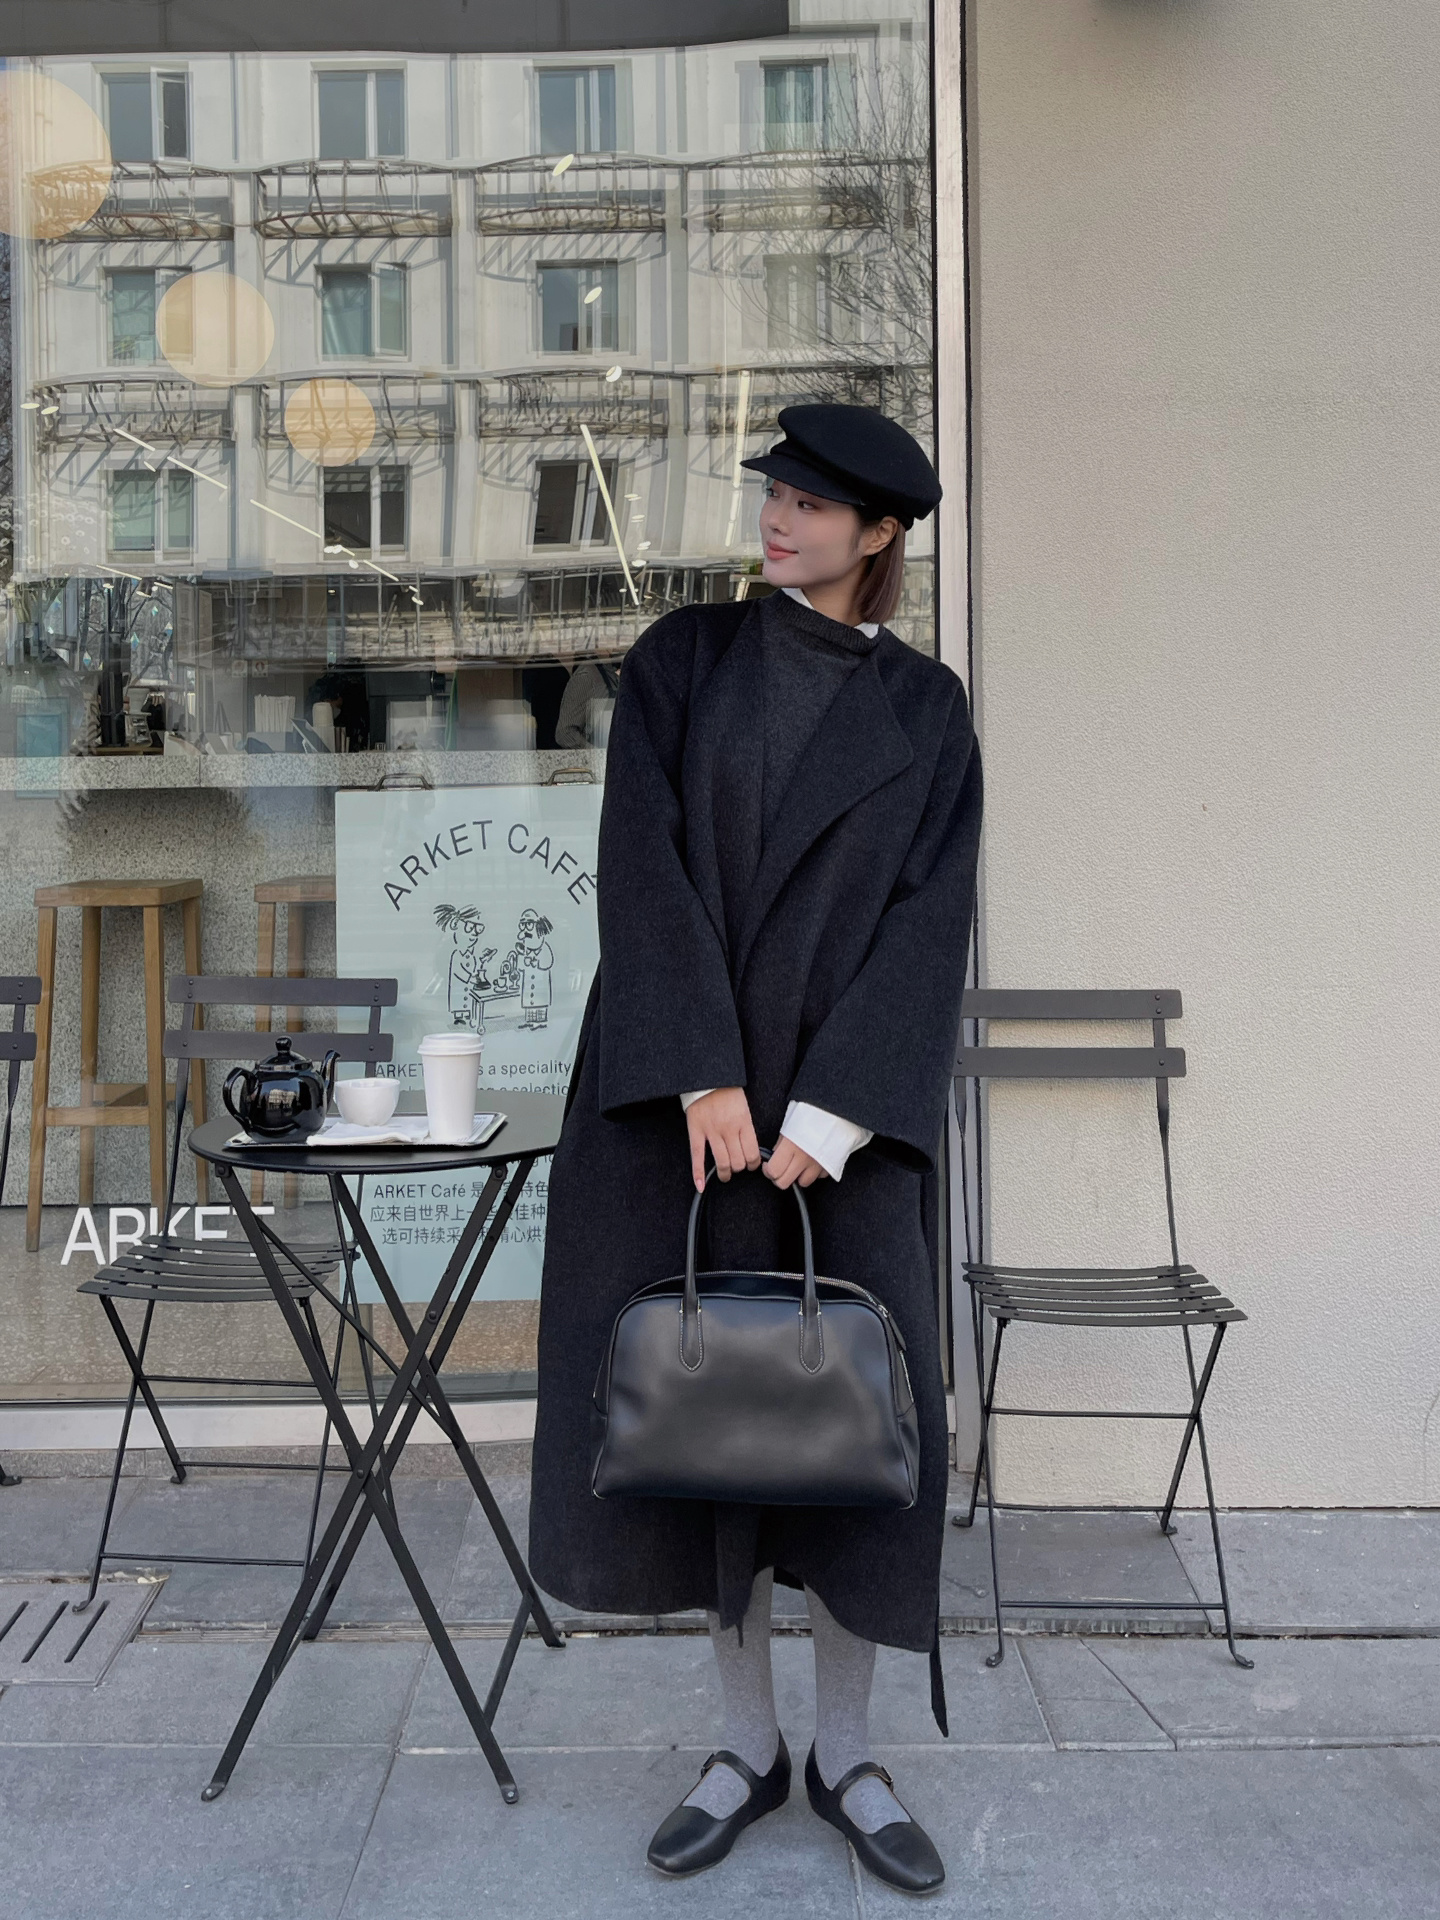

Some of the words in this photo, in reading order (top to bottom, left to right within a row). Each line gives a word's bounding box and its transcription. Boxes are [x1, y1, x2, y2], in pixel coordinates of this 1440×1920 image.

[383, 819, 493, 911] ARKET
[488, 1064, 496, 1075] a
[501, 1060, 571, 1078] speciality
[373, 1184, 427, 1198] ARKET
[431, 1183, 466, 1198] Café
